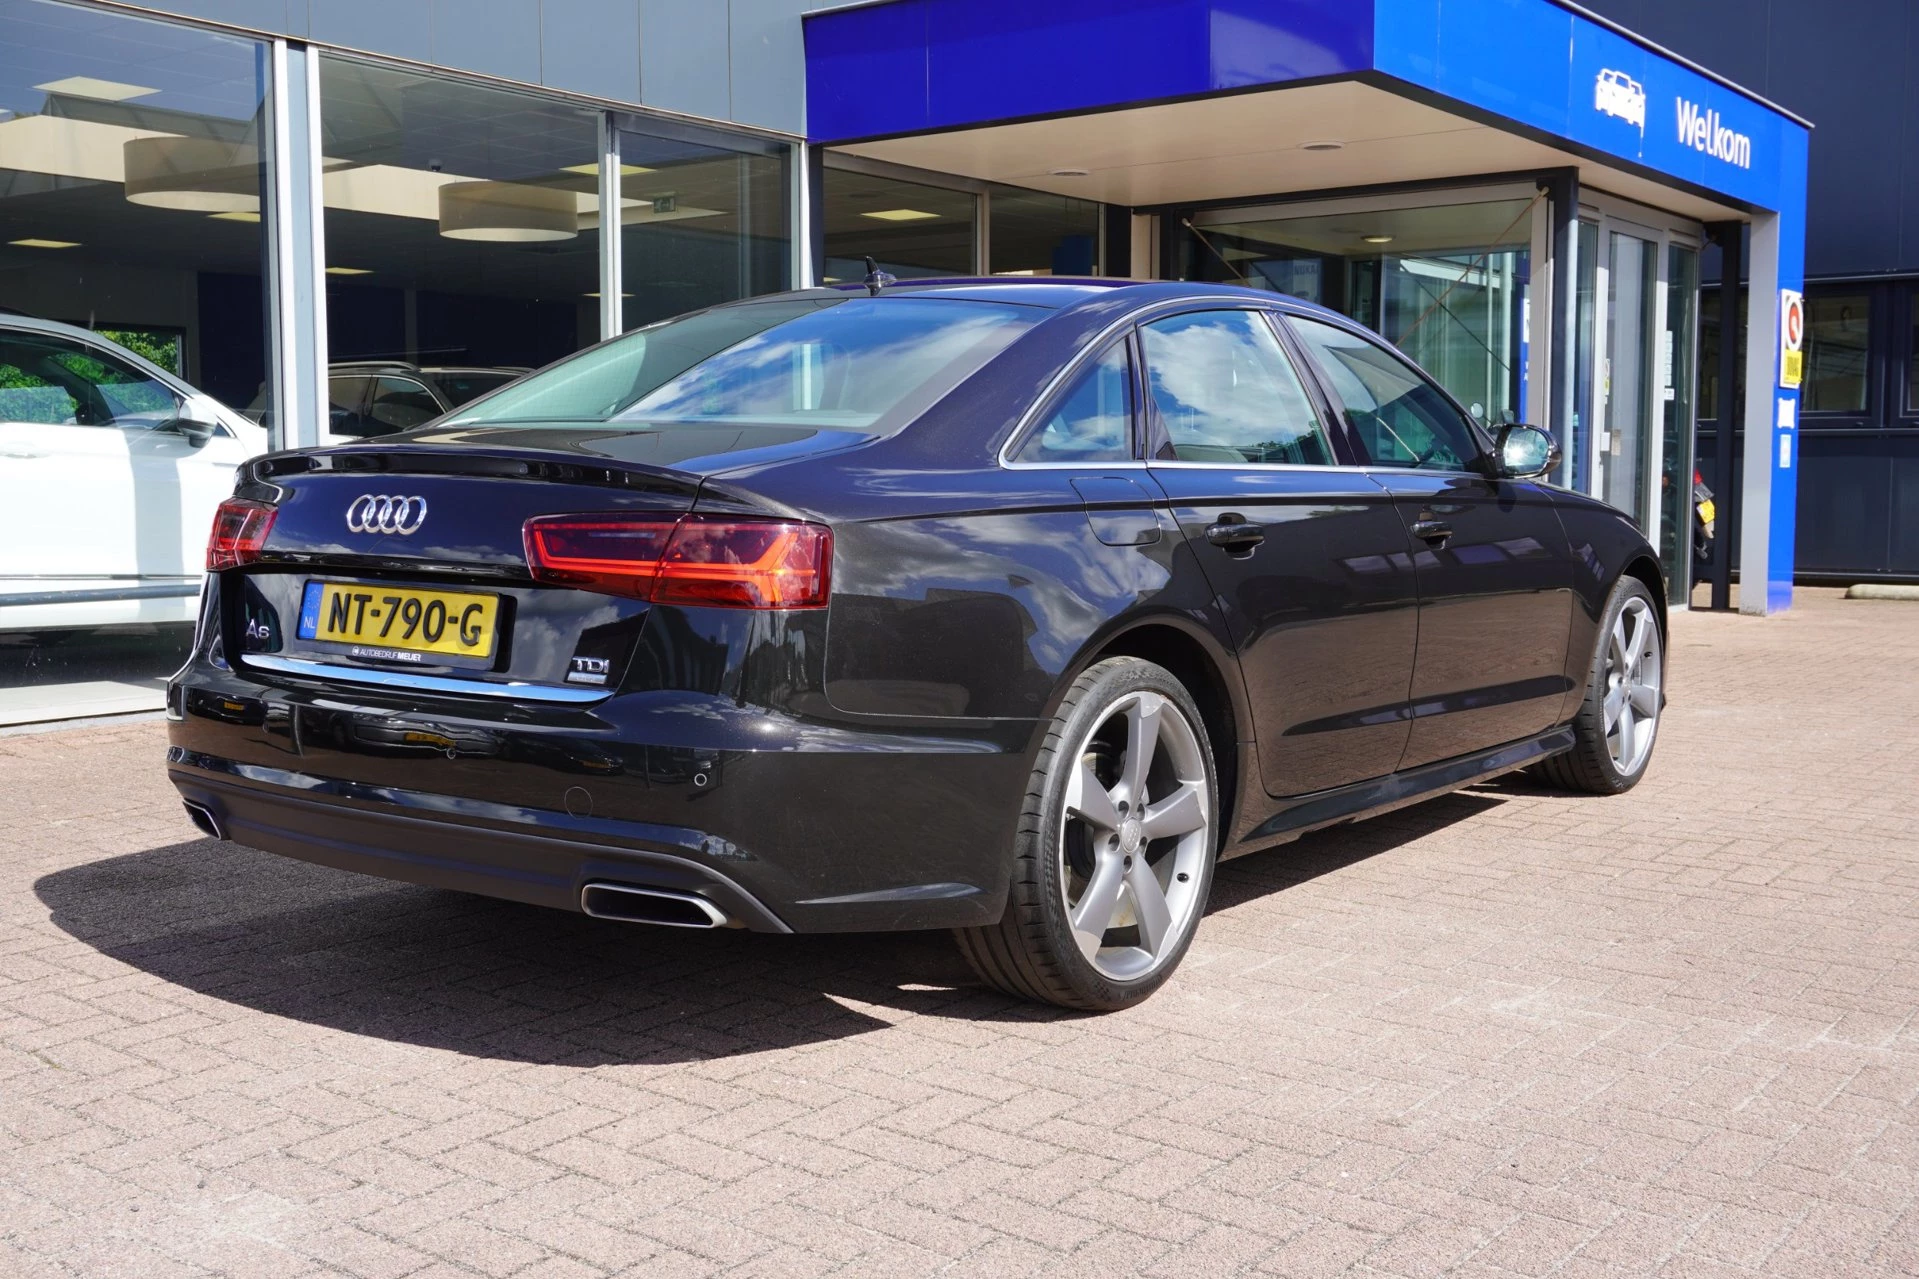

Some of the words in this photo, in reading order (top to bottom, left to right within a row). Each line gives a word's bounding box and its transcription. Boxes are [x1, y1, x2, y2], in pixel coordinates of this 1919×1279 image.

[1676, 96, 1750, 169] Welkom
[245, 618, 270, 640] A6
[303, 616, 316, 629] NL
[327, 592, 483, 646] NT-790-G
[572, 656, 610, 673] TDI
